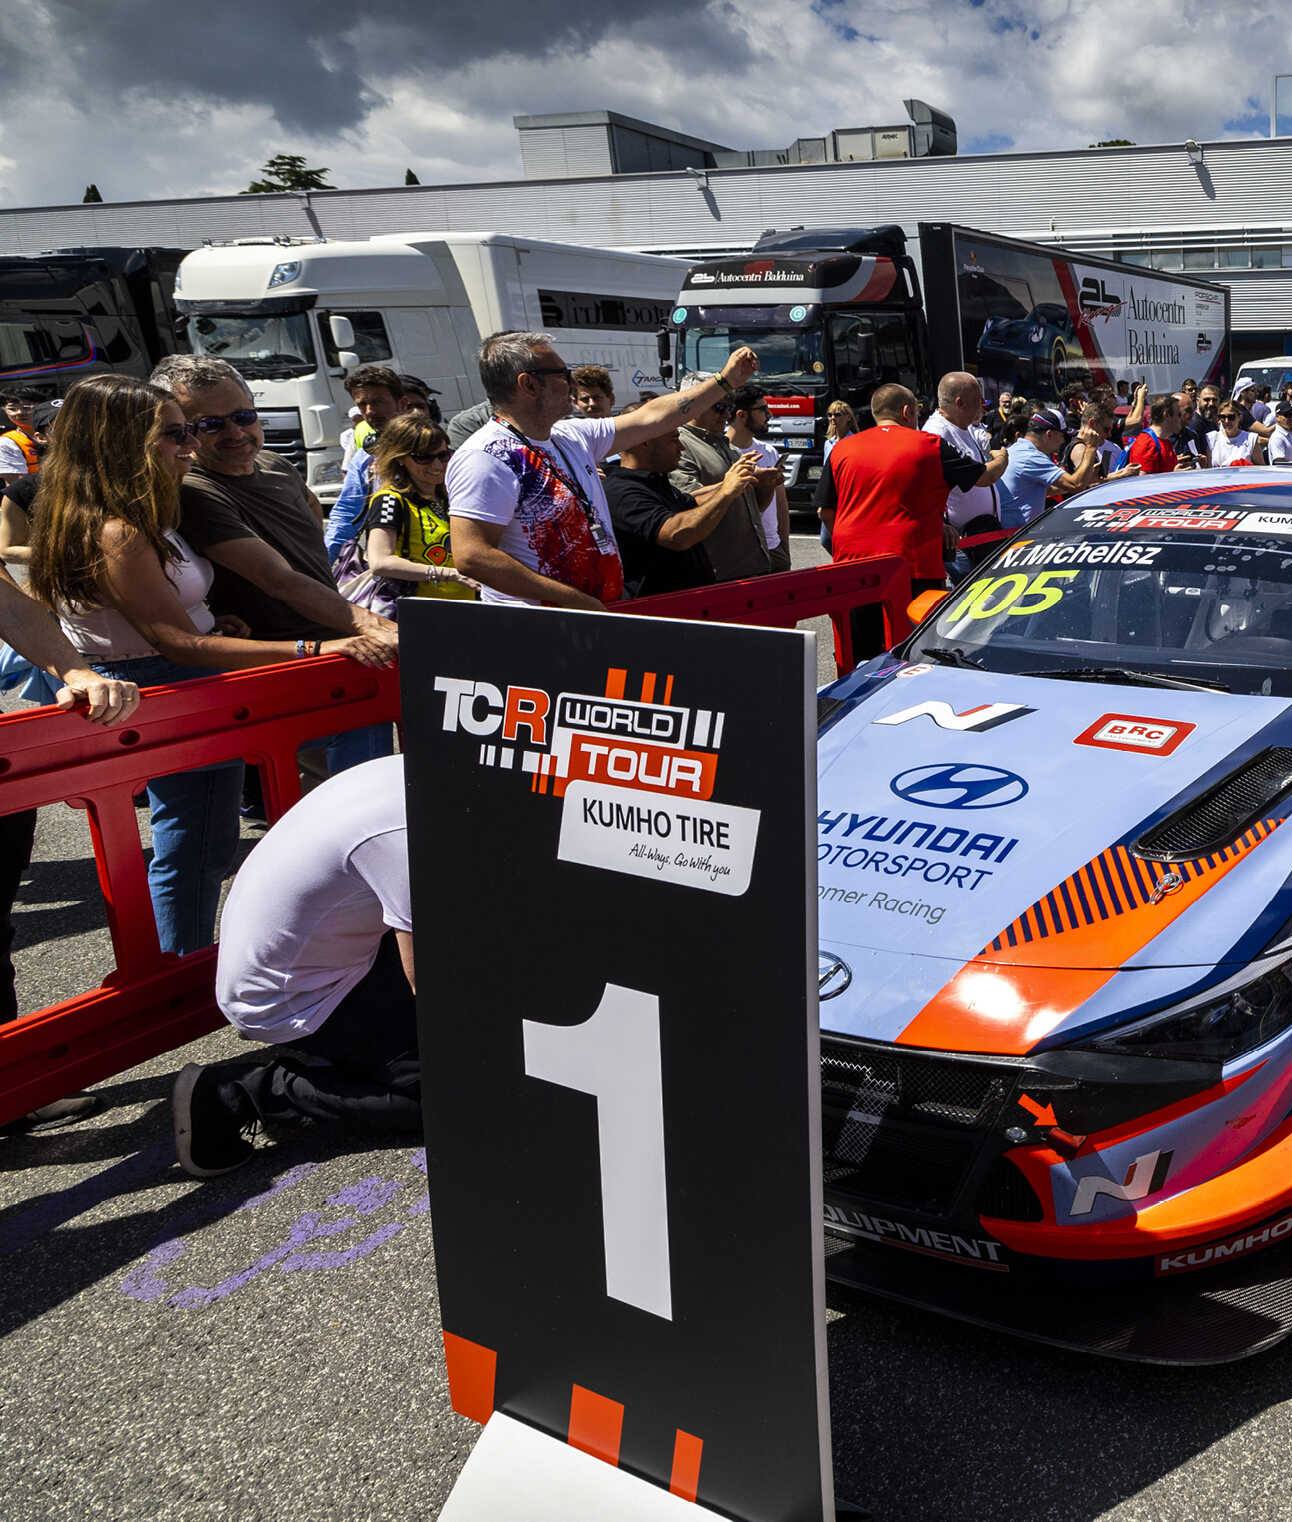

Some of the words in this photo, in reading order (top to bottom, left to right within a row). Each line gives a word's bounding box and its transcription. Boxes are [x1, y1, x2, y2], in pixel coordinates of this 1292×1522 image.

[718, 271, 762, 282] Autocentri
[764, 270, 804, 281] Balduina
[1128, 286, 1186, 325] Autocentri
[1128, 329, 1180, 365] Balduina
[1073, 508, 1140, 522] TCR
[1145, 518, 1228, 529] TOUR
[992, 541, 1162, 569] N.Michelisz
[946, 570, 1080, 622] 105
[434, 676, 550, 746] TCR
[565, 701, 675, 737] WORLD
[1108, 725, 1164, 739] BRC
[580, 743, 702, 792] TOUR
[582, 798, 671, 838] KUMHO
[676, 815, 730, 850] TIRE
[818, 811, 1019, 863] HYUNDAI
[711, 865, 731, 882] you
[817, 843, 993, 890] OTORSPORT
[869, 892, 946, 925] Racing
[522, 983, 673, 1322] 1
[824, 1204, 1001, 1261] QUIPMENT
